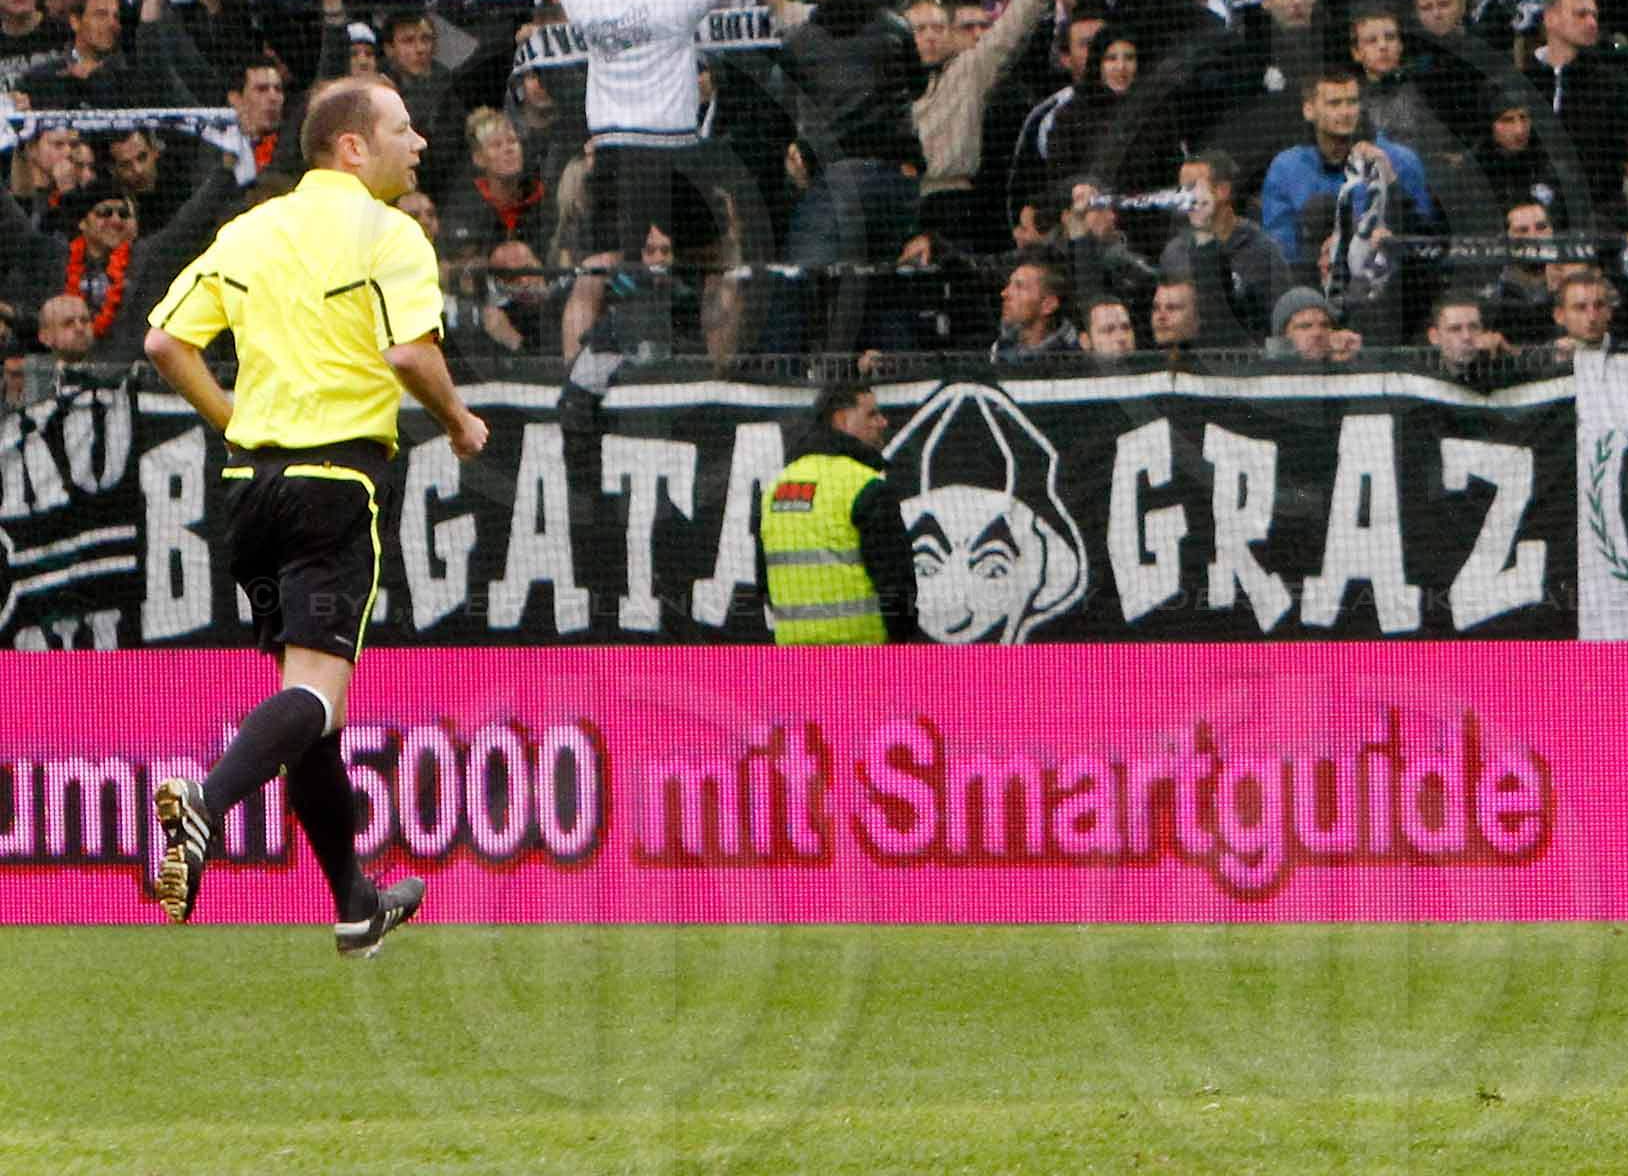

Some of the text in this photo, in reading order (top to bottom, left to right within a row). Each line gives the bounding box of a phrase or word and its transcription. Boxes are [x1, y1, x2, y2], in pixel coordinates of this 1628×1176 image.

[1105, 412, 1548, 636] GRAZ
[340, 719, 600, 862] 5000
[643, 719, 828, 862] mit
[850, 714, 1552, 902] Smartguide
